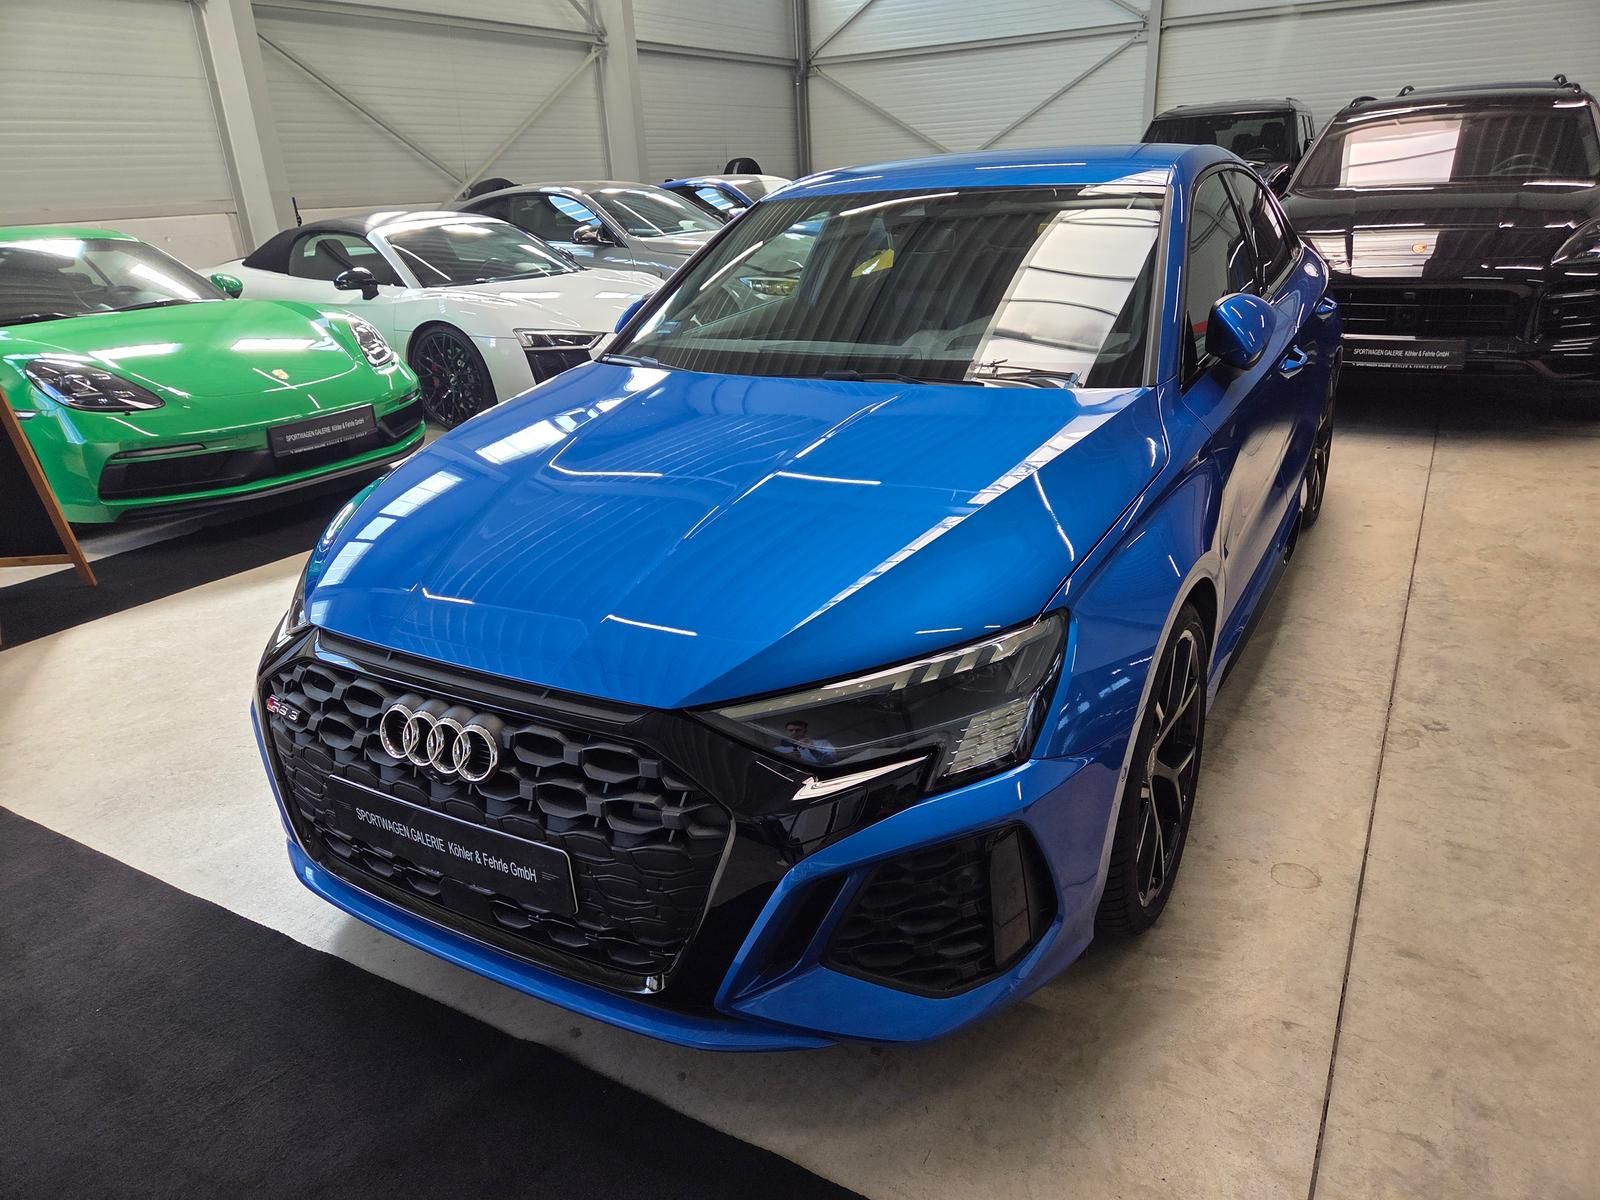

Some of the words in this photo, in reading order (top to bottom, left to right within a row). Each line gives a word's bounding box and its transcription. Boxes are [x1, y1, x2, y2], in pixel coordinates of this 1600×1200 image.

[355, 807, 411, 839] SPORTWAGEN
[410, 828, 446, 853] GALERIE
[446, 841, 474, 862] Köhler
[474, 850, 482, 864] &
[482, 853, 509, 874] Fehrle
[509, 862, 537, 882] GmbH
